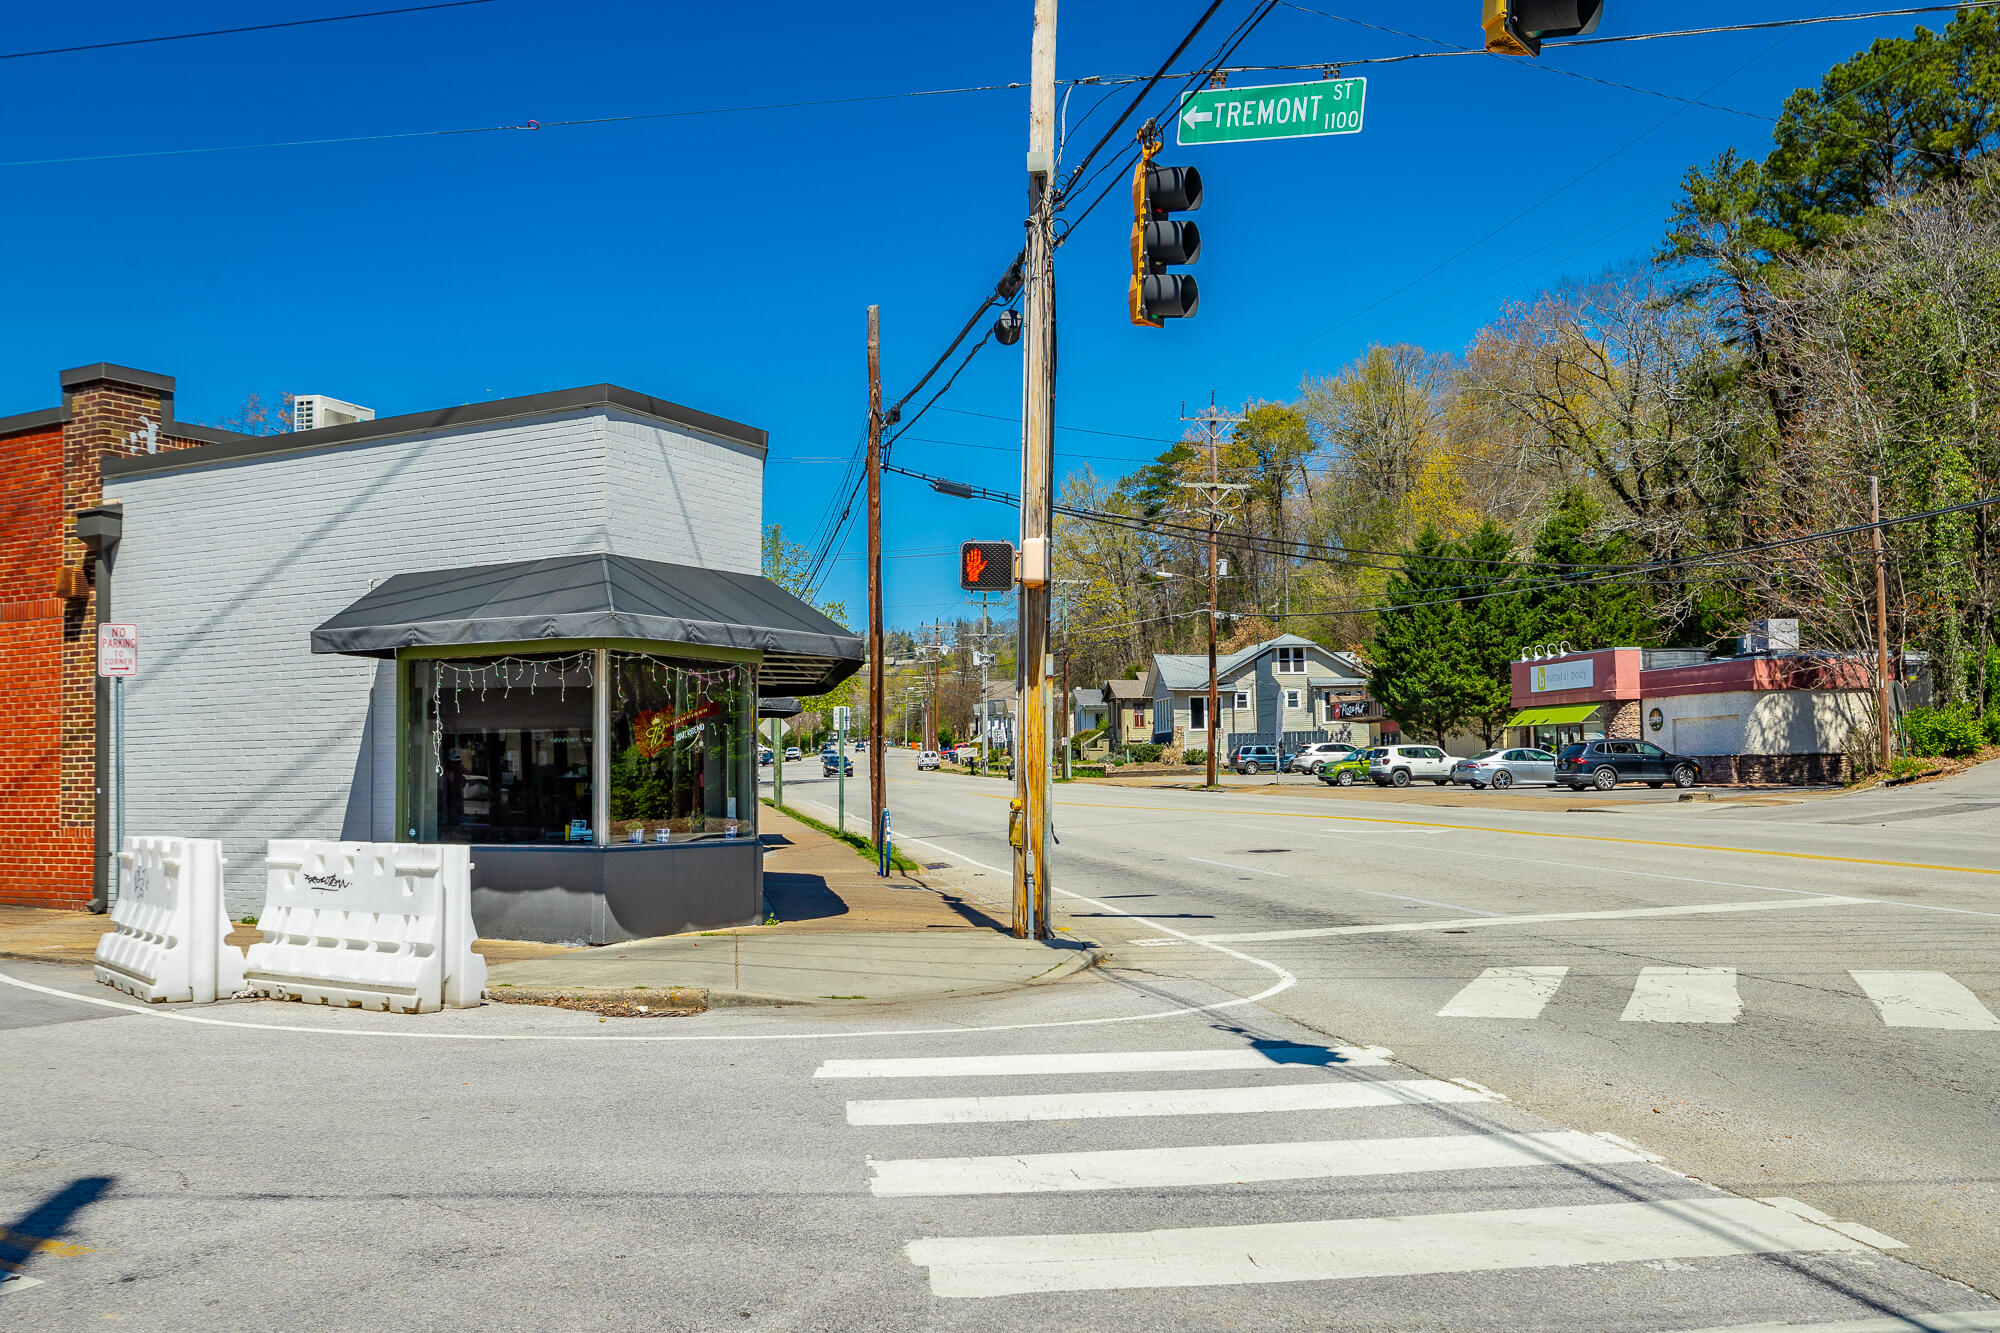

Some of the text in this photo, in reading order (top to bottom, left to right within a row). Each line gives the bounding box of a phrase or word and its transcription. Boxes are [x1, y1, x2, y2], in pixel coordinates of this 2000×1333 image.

[1333, 82, 1354, 101] ST
[1214, 95, 1322, 128] TREMONT
[1324, 110, 1359, 130] 1100
[111, 627, 126, 637] NO
[102, 638, 135, 648] PARKING
[104, 657, 133, 665] CORNER
[1546, 669, 1587, 683] natural body
